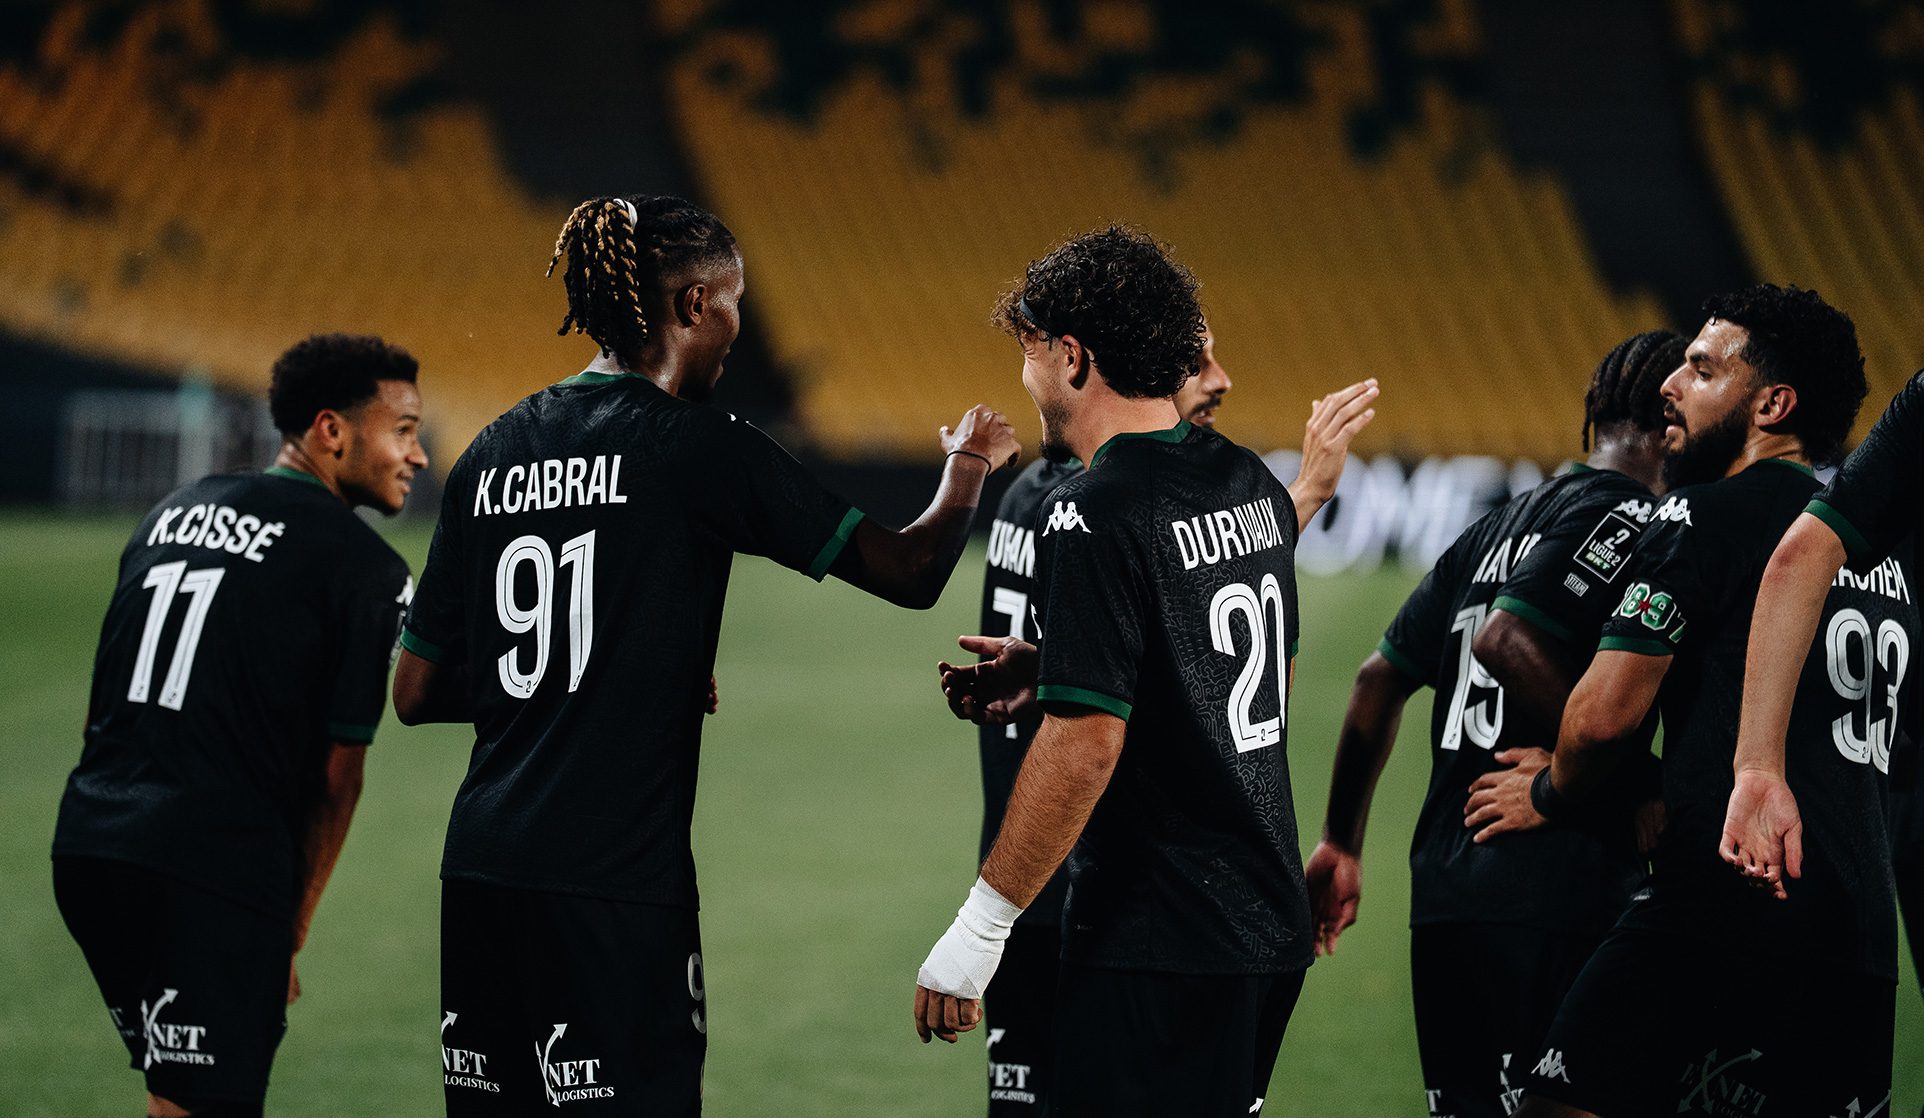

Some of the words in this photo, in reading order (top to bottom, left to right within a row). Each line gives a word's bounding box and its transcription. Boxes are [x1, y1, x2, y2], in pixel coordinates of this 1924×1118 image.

[473, 454, 628, 517] K.CABRAL
[147, 503, 286, 563] K.CISSÉ
[1171, 497, 1283, 570] DURIVAUX
[1831, 555, 1911, 606] ACHEM
[127, 560, 226, 711] 11
[496, 529, 596, 698] 91
[1826, 608, 1909, 775] 93
[444, 1073, 501, 1093] LOGISTICS
[556, 1085, 615, 1103] LOGISTICS
